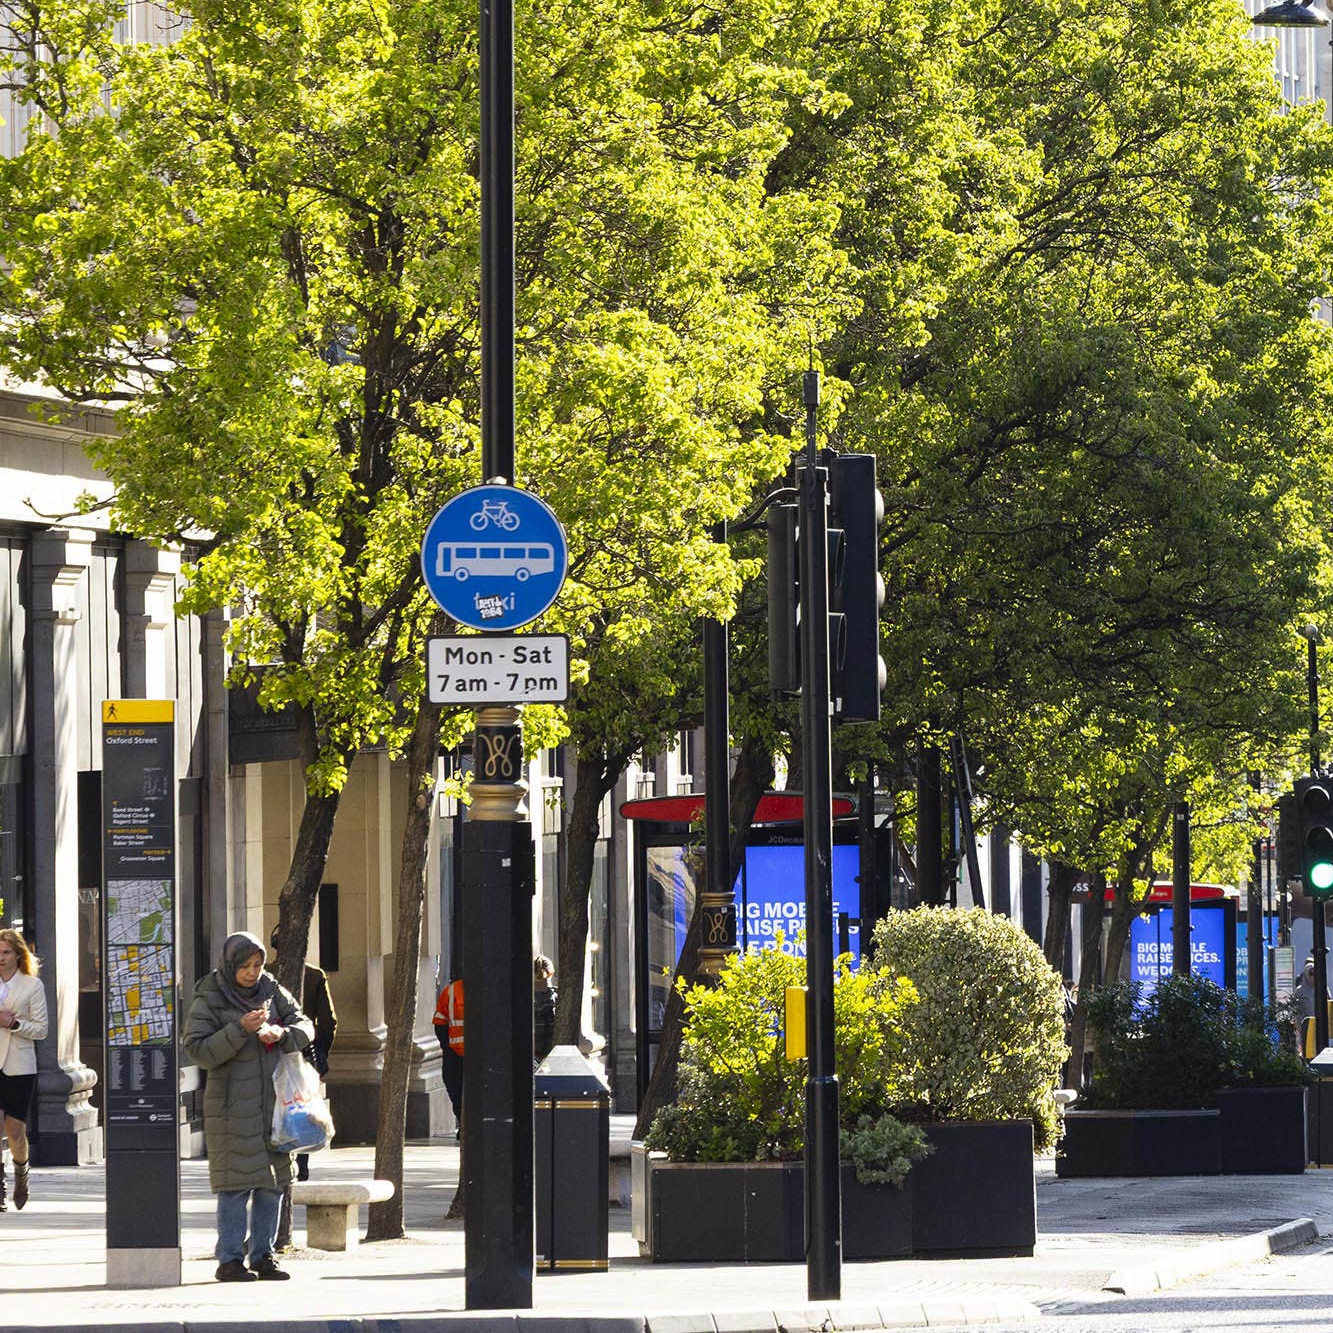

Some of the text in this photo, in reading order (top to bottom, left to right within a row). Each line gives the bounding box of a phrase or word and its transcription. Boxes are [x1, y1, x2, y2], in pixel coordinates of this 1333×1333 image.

[473, 592, 515, 610] txi
[445, 647, 493, 665] Mon
[512, 646, 552, 664] Sat
[133, 736, 158, 744] Street
[768, 835, 805, 844] JCDecau
[1137, 942, 1158, 953] BIG
[1137, 953, 1173, 963] RAISE
[1137, 965, 1158, 976] WE
